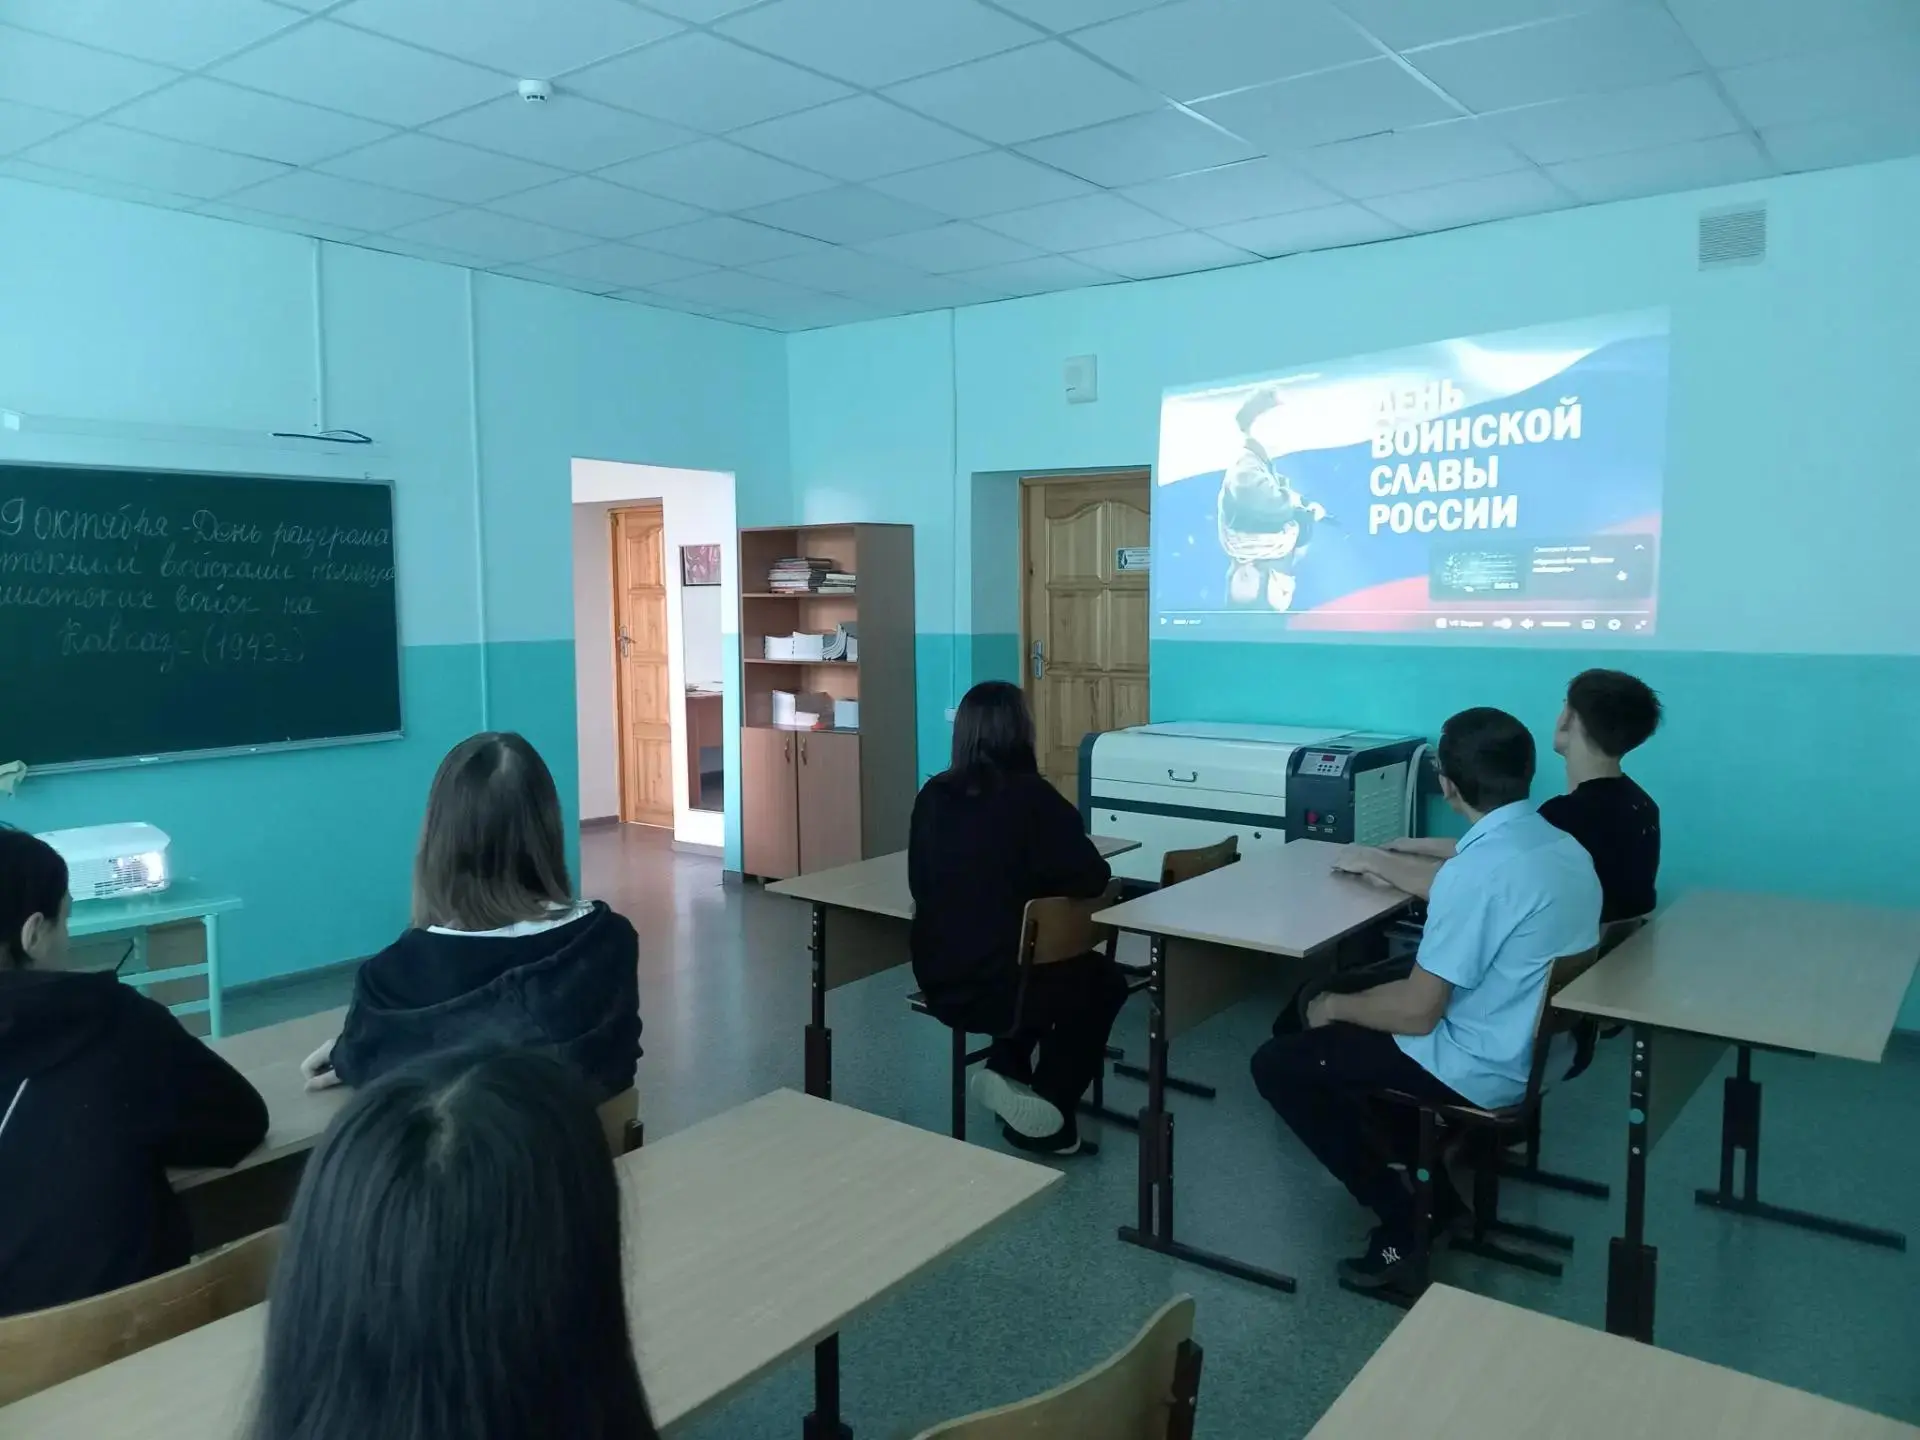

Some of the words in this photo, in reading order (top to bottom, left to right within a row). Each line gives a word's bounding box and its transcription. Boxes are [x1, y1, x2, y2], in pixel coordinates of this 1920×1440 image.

[1371, 395, 1582, 459] ВОИНСКОЙ
[1369, 455, 1499, 497] СЛАВЫ
[1368, 495, 1518, 535] РОССИИ
